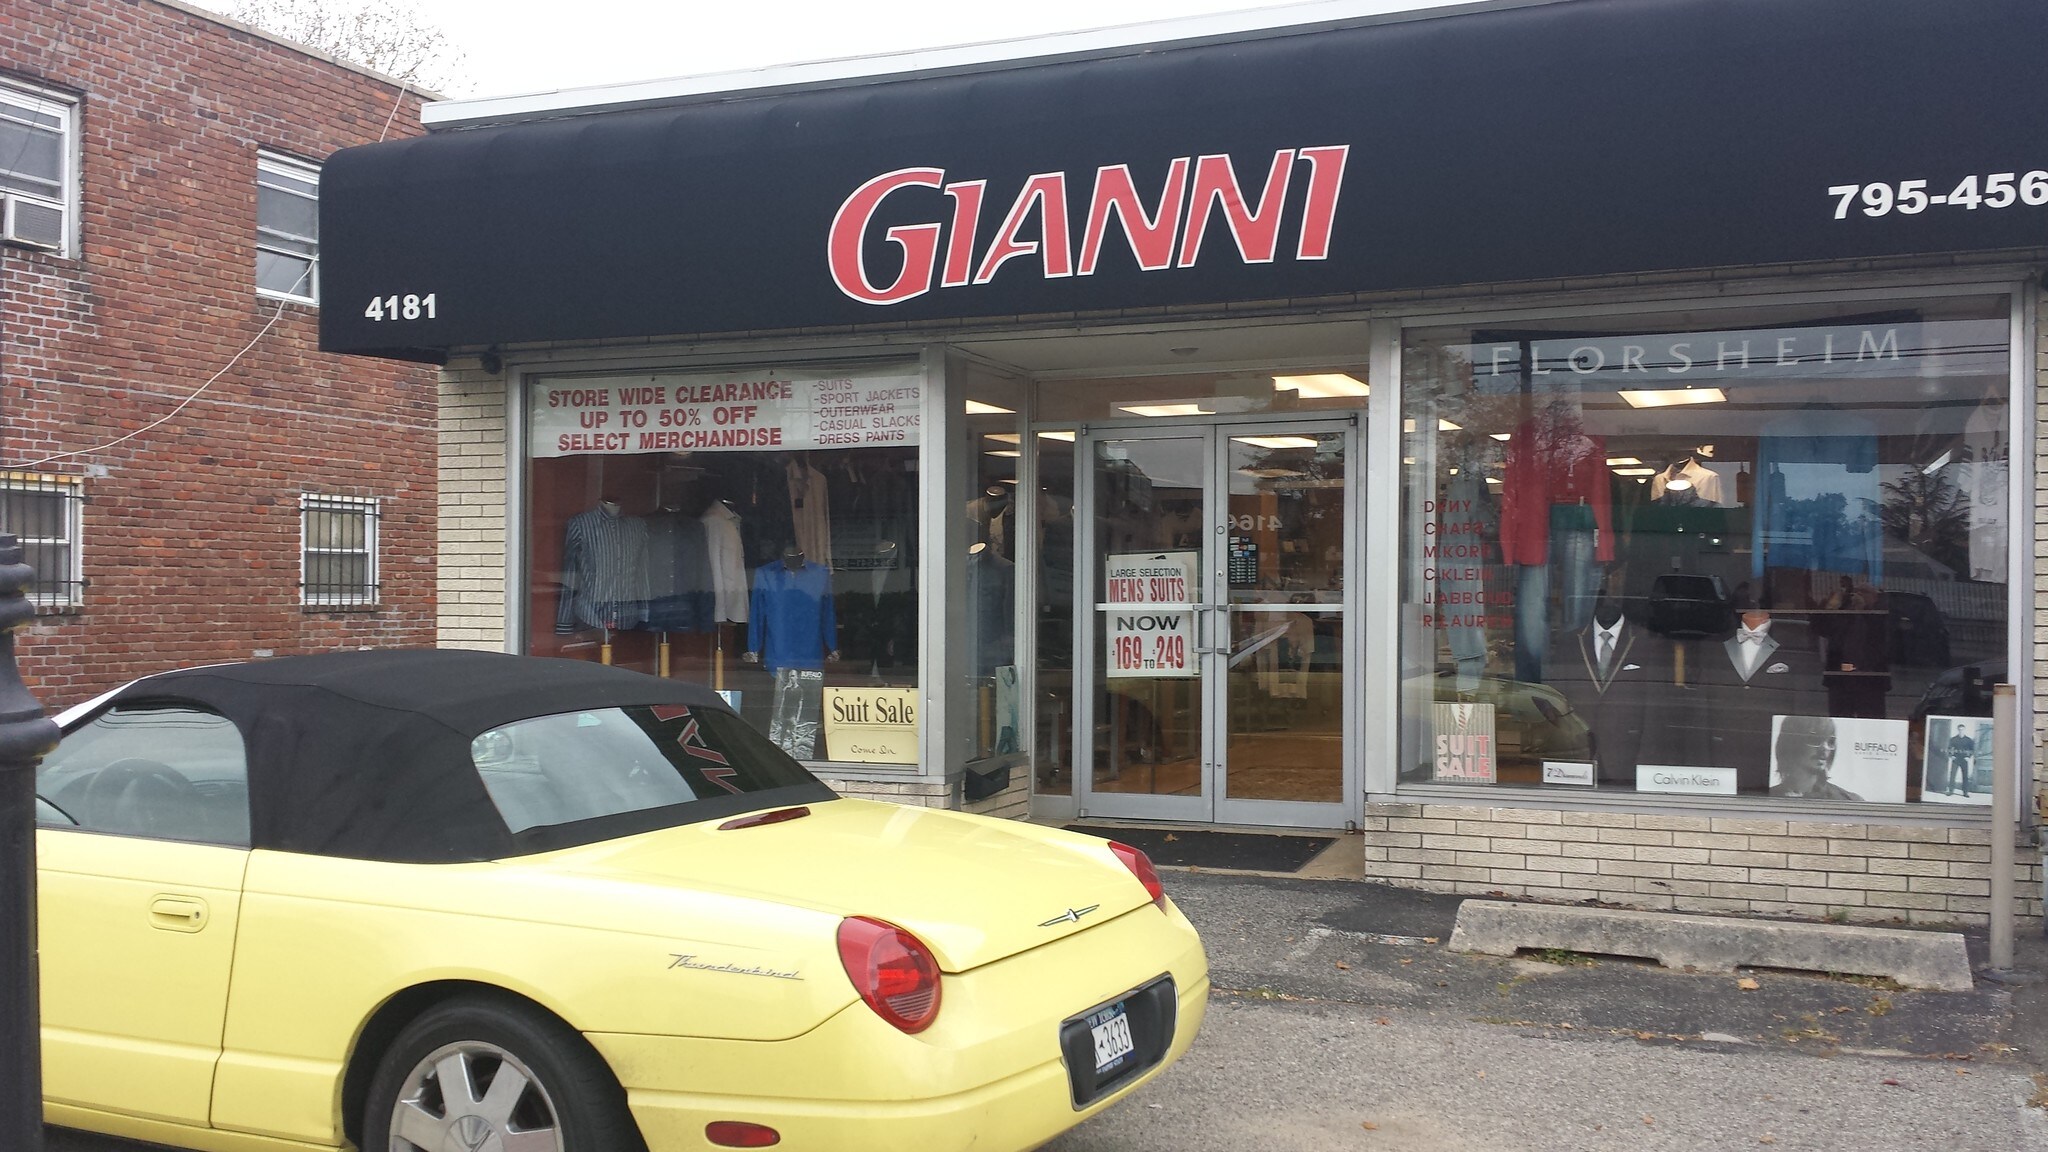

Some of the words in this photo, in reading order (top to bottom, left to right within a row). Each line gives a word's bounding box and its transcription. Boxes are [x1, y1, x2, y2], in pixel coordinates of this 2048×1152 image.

[1828, 170, 2048, 220] 795-456
[827, 144, 1350, 305] GIANNI
[364, 293, 436, 321] 4181
[1491, 328, 1900, 376] FLORSHEIM
[548, 389, 609, 408] STORE
[618, 386, 666, 406] WIDE
[675, 380, 793, 404] CLEARANCE
[866, 387, 919, 402] JACKETS
[580, 411, 609, 429] UP
[619, 409, 648, 428] TO
[658, 407, 701, 427] 50%
[713, 405, 758, 425] OFF
[872, 415, 920, 429] SLACKS
[558, 432, 630, 451] SELECT
[639, 427, 782, 450] MERCHANDISE
[866, 430, 905, 442] PANTS
[1110, 569, 1136, 578] LARGE
[1140, 567, 1182, 577] SELECTION
[1109, 578, 1144, 602] MENS
[1150, 577, 1184, 602] SUITS
[1117, 615, 1180, 631] NOW
[1143, 659, 1155, 669] TO
[833, 696, 869, 722] Suit
[876, 696, 914, 723] Sale
[851, 744, 876, 754] Come
[1436, 734, 1490, 756] SUIT
[1855, 742, 1898, 753] BUFFALO
[1436, 757, 1492, 778] SALE
